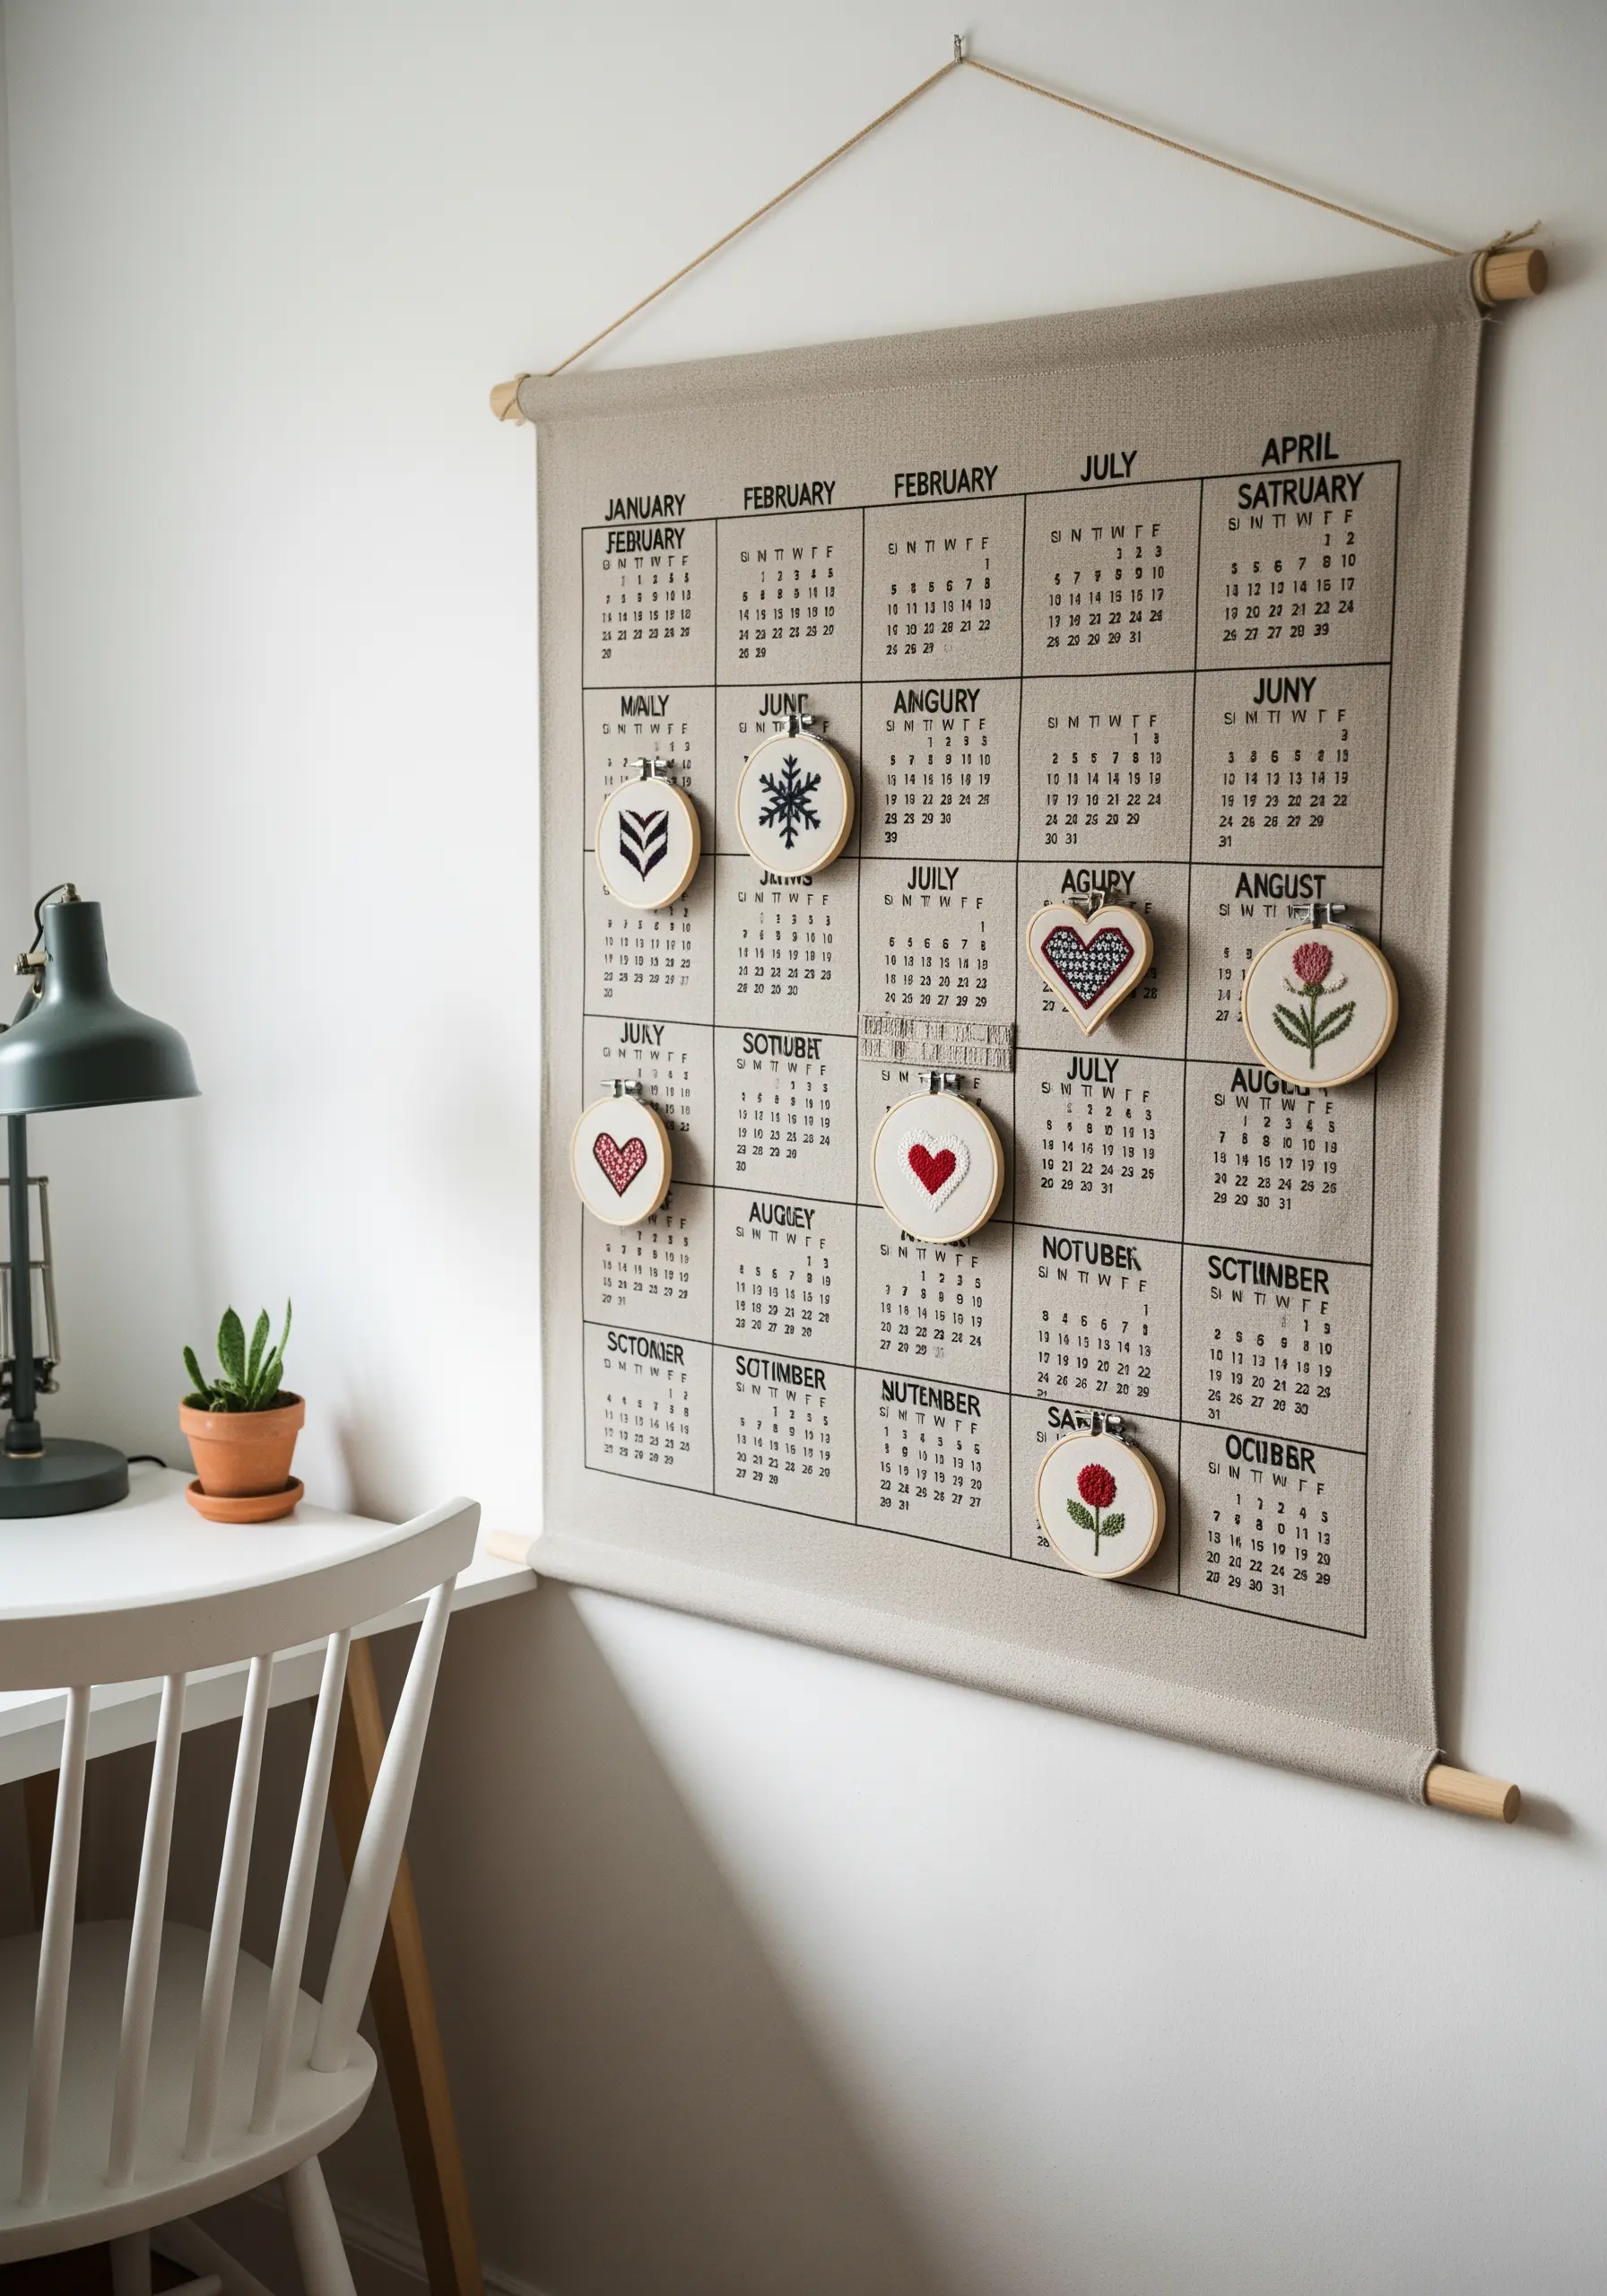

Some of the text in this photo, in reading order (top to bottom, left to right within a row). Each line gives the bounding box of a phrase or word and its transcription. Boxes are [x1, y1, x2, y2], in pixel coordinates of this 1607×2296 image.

[1261, 431, 1339, 467] APRIL
[1080, 450, 1138, 483] JULY
[894, 465, 998, 499] FEBRUARY
[743, 481, 836, 510] FEBRUARY
[1238, 471, 1365, 509] SATRUARY
[604, 494, 686, 521] JANUARY
[1343, 508, 1354, 525] F
[1151, 522, 1161, 538] F
[943, 538, 958, 552] W
[1324, 530, 1356, 547] 1 2
[792, 547, 804, 561] W
[1134, 544, 1163, 560] 2 3
[985, 557, 990, 570] 1
[1252, 552, 1357, 574] 5 6 7 8 10
[1073, 565, 1165, 586] 7 10
[928, 577, 973, 594] 5 6 7
[1247, 576, 1356, 597] 12 14 17
[887, 598, 973, 616] 10 11 14
[1245, 602, 1307, 620] 20 21
[960, 618, 991, 633] 21 22
[1266, 625, 1283, 640] 27
[1128, 630, 1142, 644] 31
[1253, 676, 1316, 705] JUNY
[1108, 713, 1158, 728] W F
[1337, 708, 1347, 723] F
[942, 718, 955, 732] W
[927, 735, 951, 748] 1 2
[1133, 732, 1139, 745] 1
[979, 753, 991, 766] 10
[1052, 751, 1120, 765] 2 7
[1047, 771, 1099, 786] 10 14
[1107, 793, 1142, 807] 21 22
[921, 812, 934, 825] 29
[1218, 813, 1325, 829] 24 29
[1044, 831, 1078, 846] 30 31
[1218, 834, 1232, 848] 31
[1235, 872, 1326, 900] ANGUST
[788, 892, 814, 906] W F
[980, 920, 986, 933] 1
[942, 937, 969, 951] 6 7
[885, 954, 897, 966] 10
[938, 975, 951, 987] 20
[936, 994, 988, 1008] 27 29
[1214, 1009, 1230, 1022] 27
[681, 1052, 688, 1064] F
[787, 1062, 798, 1074] W
[1066, 1056, 1119, 1083] JULY
[1142, 1090, 1151, 1103] F
[1105, 1105, 1152, 1122] 2 3
[1263, 1115, 1293, 1130] 2 3
[819, 1135, 830, 1146] 24
[1219, 1130, 1227, 1144] 7
[1061, 1160, 1115, 1176] 21 24
[1323, 1161, 1338, 1175] 19
[1100, 1181, 1114, 1195] 31
[1234, 1174, 1292, 1191] 22 24
[1278, 1196, 1292, 1211] 31
[786, 1232, 797, 1245] W
[806, 1255, 812, 1267] 1
[934, 1249, 978, 1269] W F
[921, 1270, 945, 1284] 1 2
[1097, 1273, 1112, 1287] W
[955, 1292, 983, 1309] 9 10
[1275, 1294, 1290, 1309] W
[784, 1306, 795, 1318] 21
[1143, 1303, 1149, 1317] 1
[881, 1320, 892, 1334] 20
[1100, 1318, 1129, 1334] 6 7
[879, 1338, 892, 1351] 27
[1098, 1337, 1111, 1352] 13
[1213, 1318, 1333, 1356] 2 6 1 10
[1210, 1348, 1224, 1361] 10
[1076, 1356, 1090, 1370] 19
[1318, 1363, 1333, 1378] 19
[1037, 1370, 1151, 1398] 24 26 26 29
[1251, 1374, 1287, 1392] 20 21
[1229, 1392, 1265, 1409] 26 27
[773, 1405, 778, 1417] 1
[1207, 1407, 1221, 1421] 31
[933, 1414, 978, 1435] W F
[970, 1478, 983, 1491] 20
[1316, 1482, 1325, 1496] F
[969, 1496, 982, 1508] 27
[1236, 1492, 1285, 1515] 1 2
[1295, 1526, 1331, 1546] 11 13
[1295, 1546, 1308, 1561] 19
[1206, 1550, 1264, 1573] 20 22
[1227, 1574, 1285, 1597] 29 31
